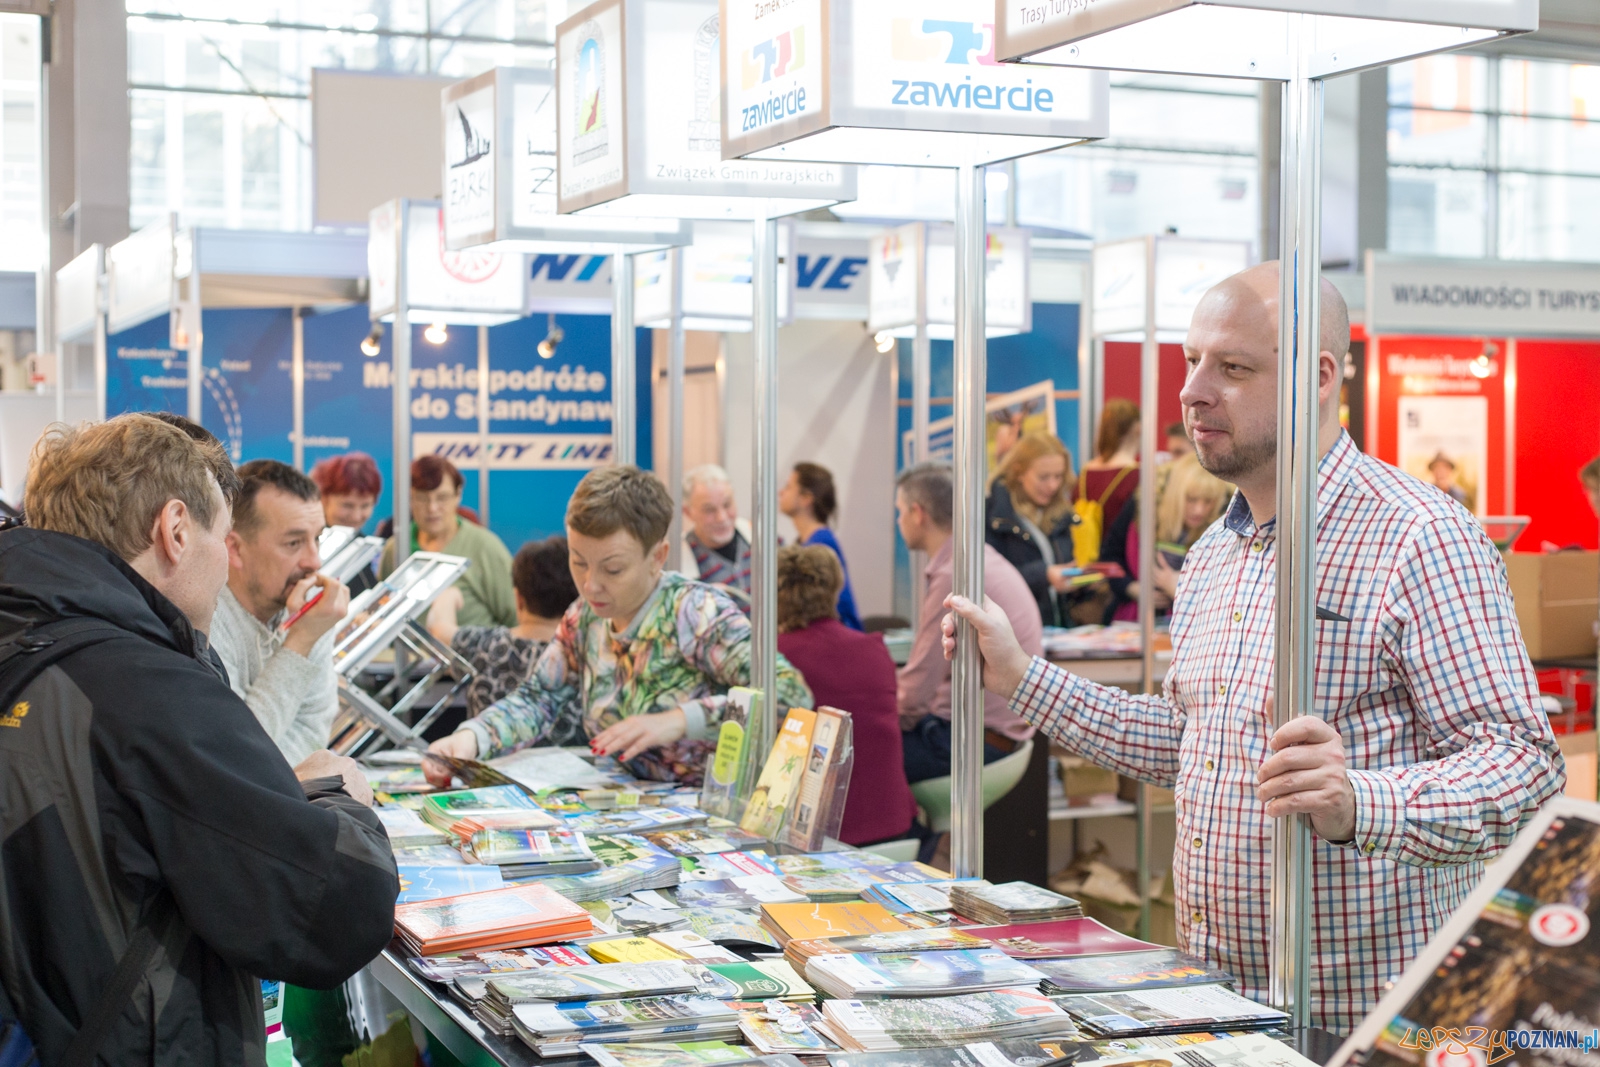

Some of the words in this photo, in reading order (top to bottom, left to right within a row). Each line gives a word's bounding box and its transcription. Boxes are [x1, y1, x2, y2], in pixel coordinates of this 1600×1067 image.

[1020, 5, 1047, 25] Trasy
[742, 80, 806, 132] zawiercie
[891, 75, 1054, 112] zawiercie
[656, 164, 716, 182] Związek
[721, 165, 759, 181] Gmin
[763, 166, 835, 185] Jurajskich
[1391, 281, 1531, 309] WIADOMOŚCI
[363, 361, 479, 390] Mrskie
[489, 364, 606, 395] podróże
[411, 392, 450, 420] do
[455, 392, 612, 425] Sandynaw
